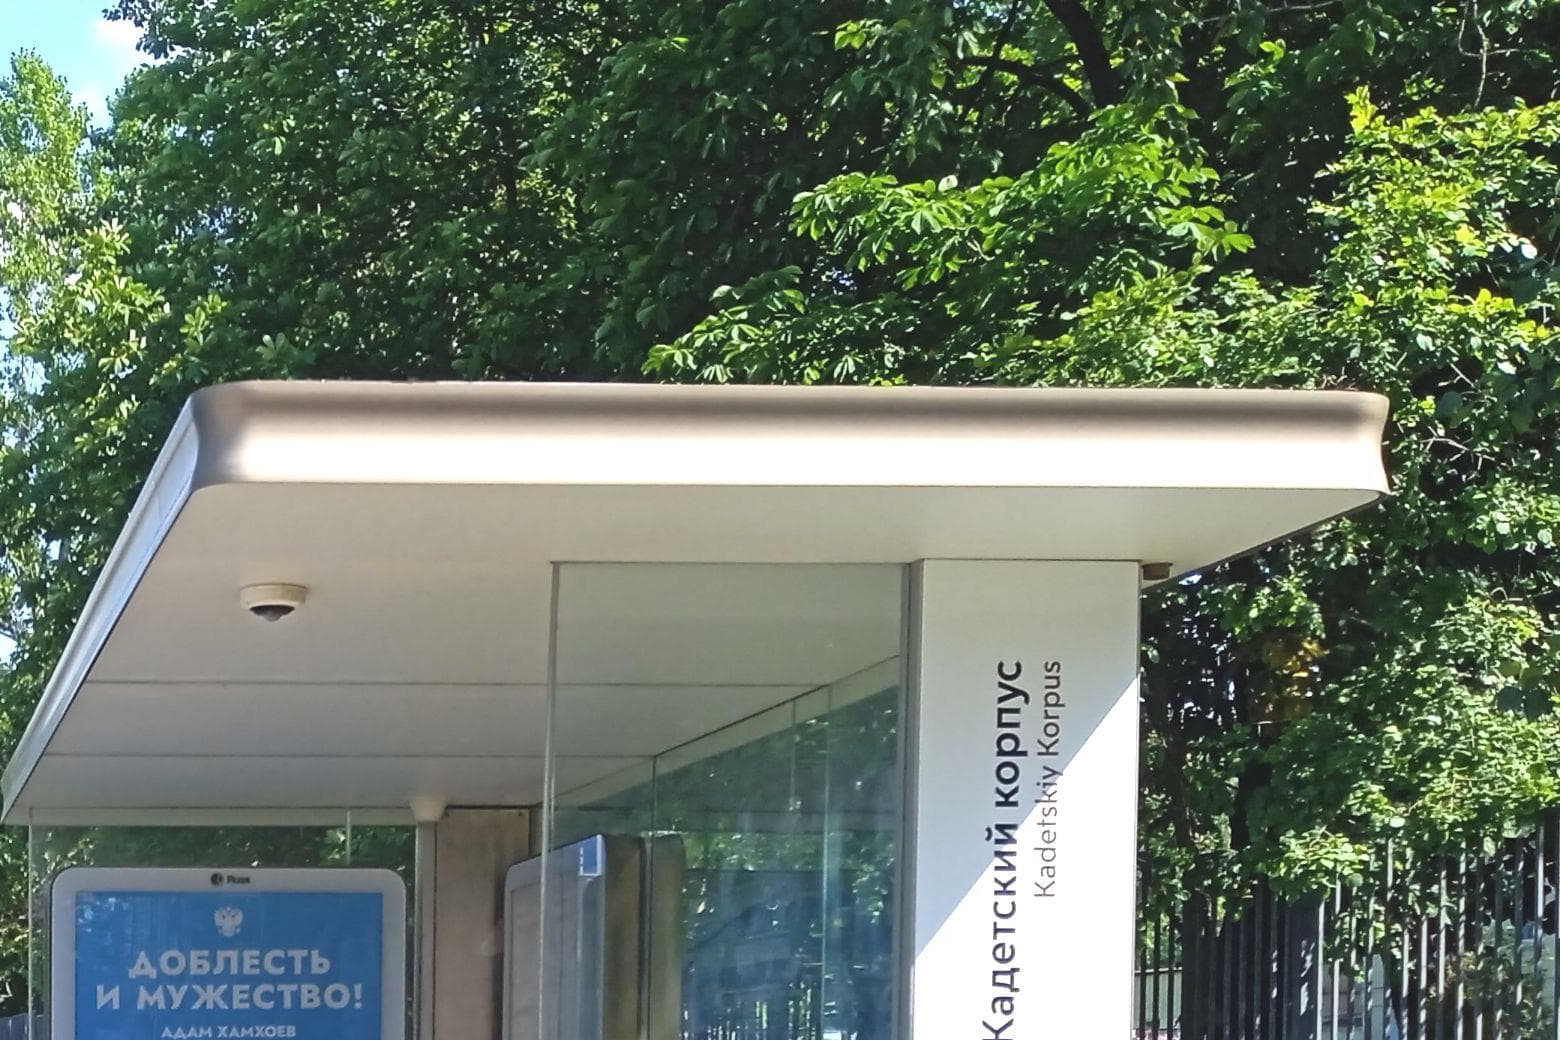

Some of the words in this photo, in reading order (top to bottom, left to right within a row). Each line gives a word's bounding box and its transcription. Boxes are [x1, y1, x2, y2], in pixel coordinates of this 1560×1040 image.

[994, 659, 1030, 808] корпус
[1036, 659, 1066, 756] Korpus
[1033, 765, 1064, 898] Kadetskiy
[128, 949, 331, 979] ДОБЛЕСТЬ
[96, 984, 121, 1010] И
[137, 982, 363, 1010] МУЖЕСТВО!
[161, 1025, 212, 1040] АДАМ
[217, 1025, 297, 1039] ХАМХОЕВ
